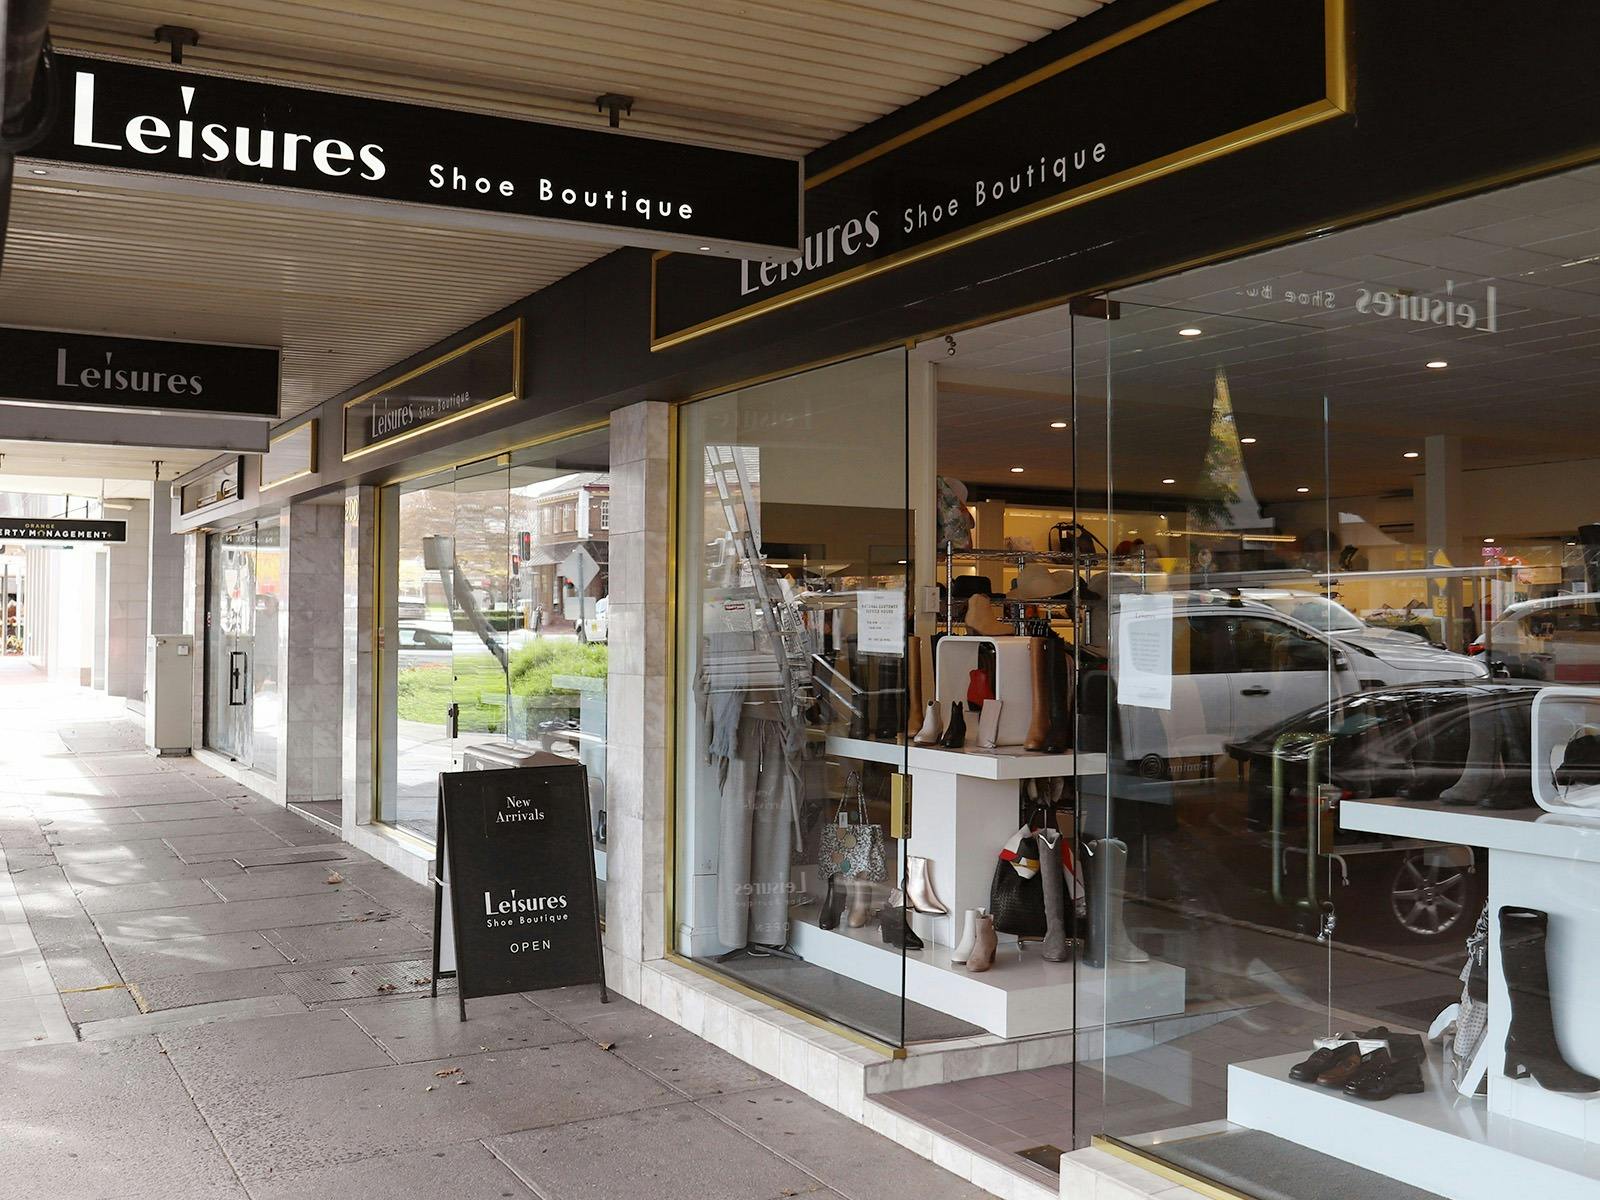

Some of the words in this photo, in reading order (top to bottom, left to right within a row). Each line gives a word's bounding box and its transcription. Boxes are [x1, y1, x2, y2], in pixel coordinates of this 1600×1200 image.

[73, 71, 386, 181] Leisures
[428, 163, 515, 197] Shoe
[539, 178, 693, 221] Boutique
[741, 210, 880, 296] Lesures
[903, 199, 958, 233] Shoe
[976, 142, 1106, 207] Boutique
[57, 348, 203, 395] Leisures
[372, 397, 414, 438] Leisures
[418, 405, 435, 420] Shoe
[437, 391, 471, 412] Boutique
[506, 796, 531, 808] New
[496, 809, 545, 823] Arrivals
[484, 889, 568, 916] Leisures
[486, 918, 513, 928] Shoe
[519, 913, 569, 925] Boutique
[509, 939, 551, 953] OPEN
